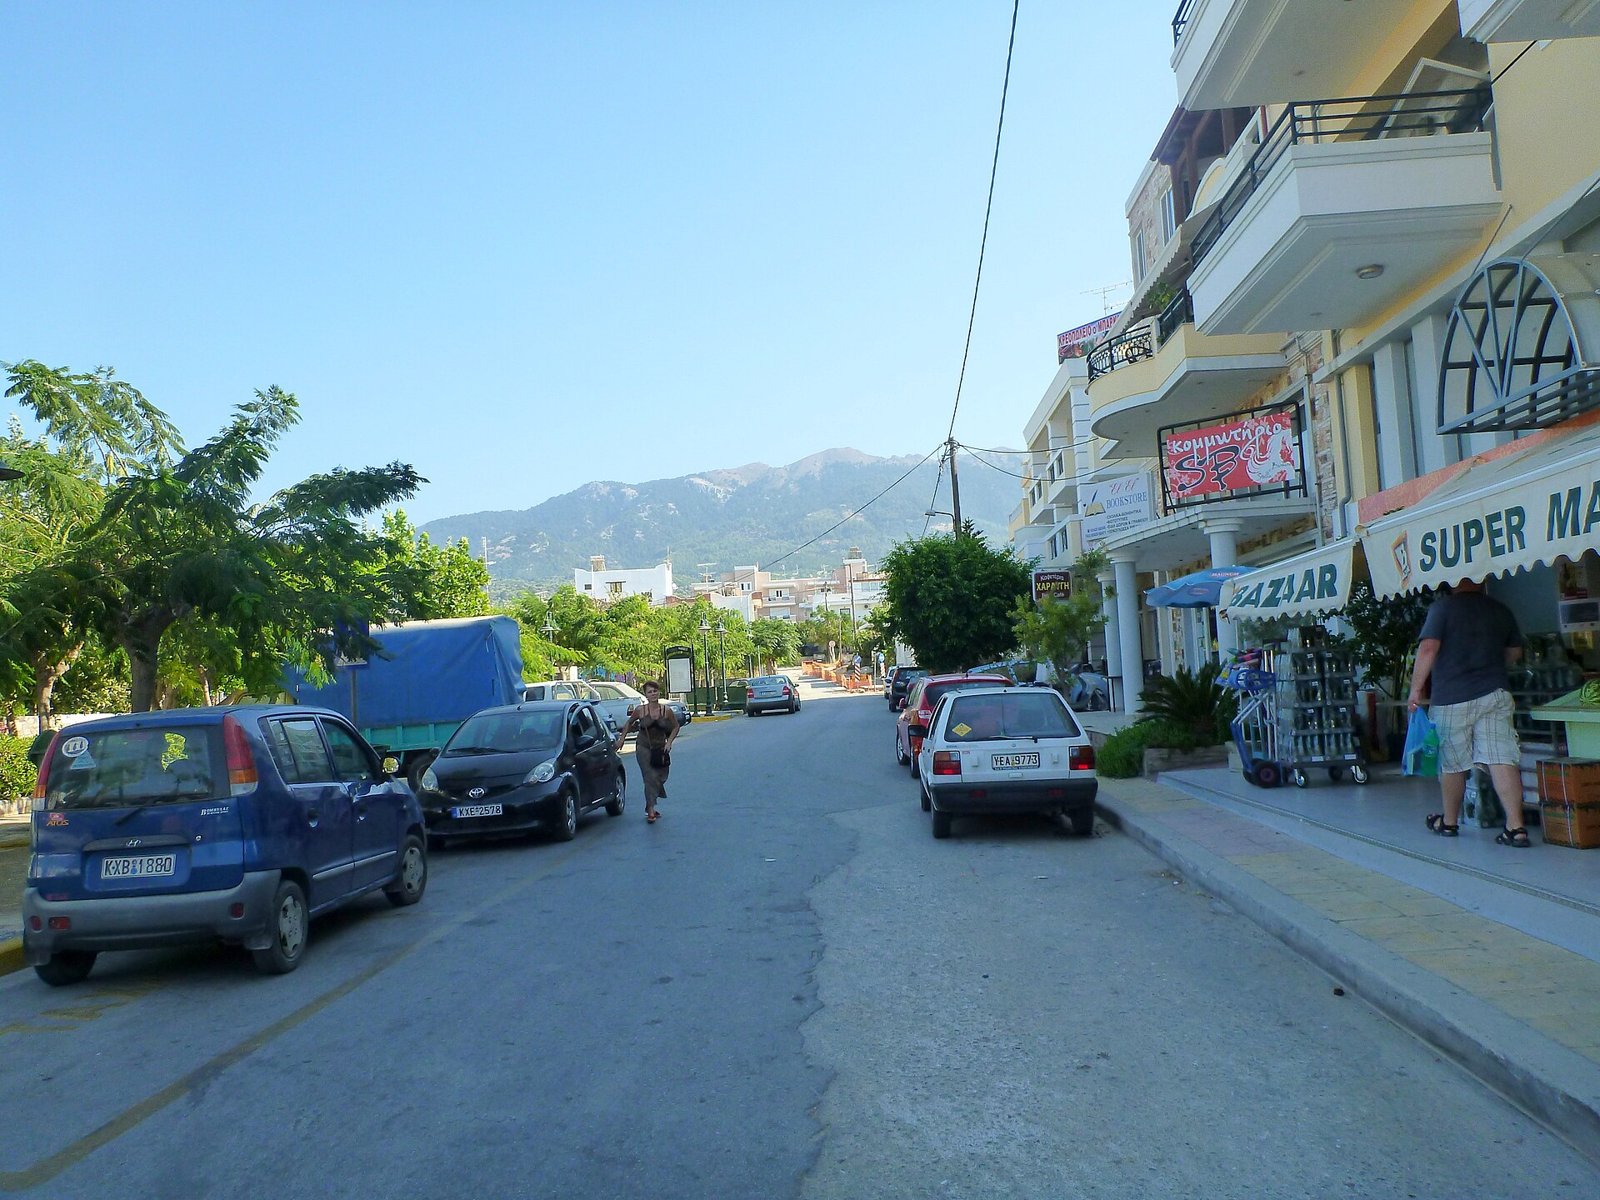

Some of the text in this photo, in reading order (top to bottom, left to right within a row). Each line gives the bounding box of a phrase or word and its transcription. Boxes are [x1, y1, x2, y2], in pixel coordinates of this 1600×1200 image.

[1106, 491, 1148, 509] BOOKSTORE
[1418, 505, 1527, 573] SUPER
[994, 754, 1038, 766] YEA 9773
[104, 857, 172, 876] KXB 1880
